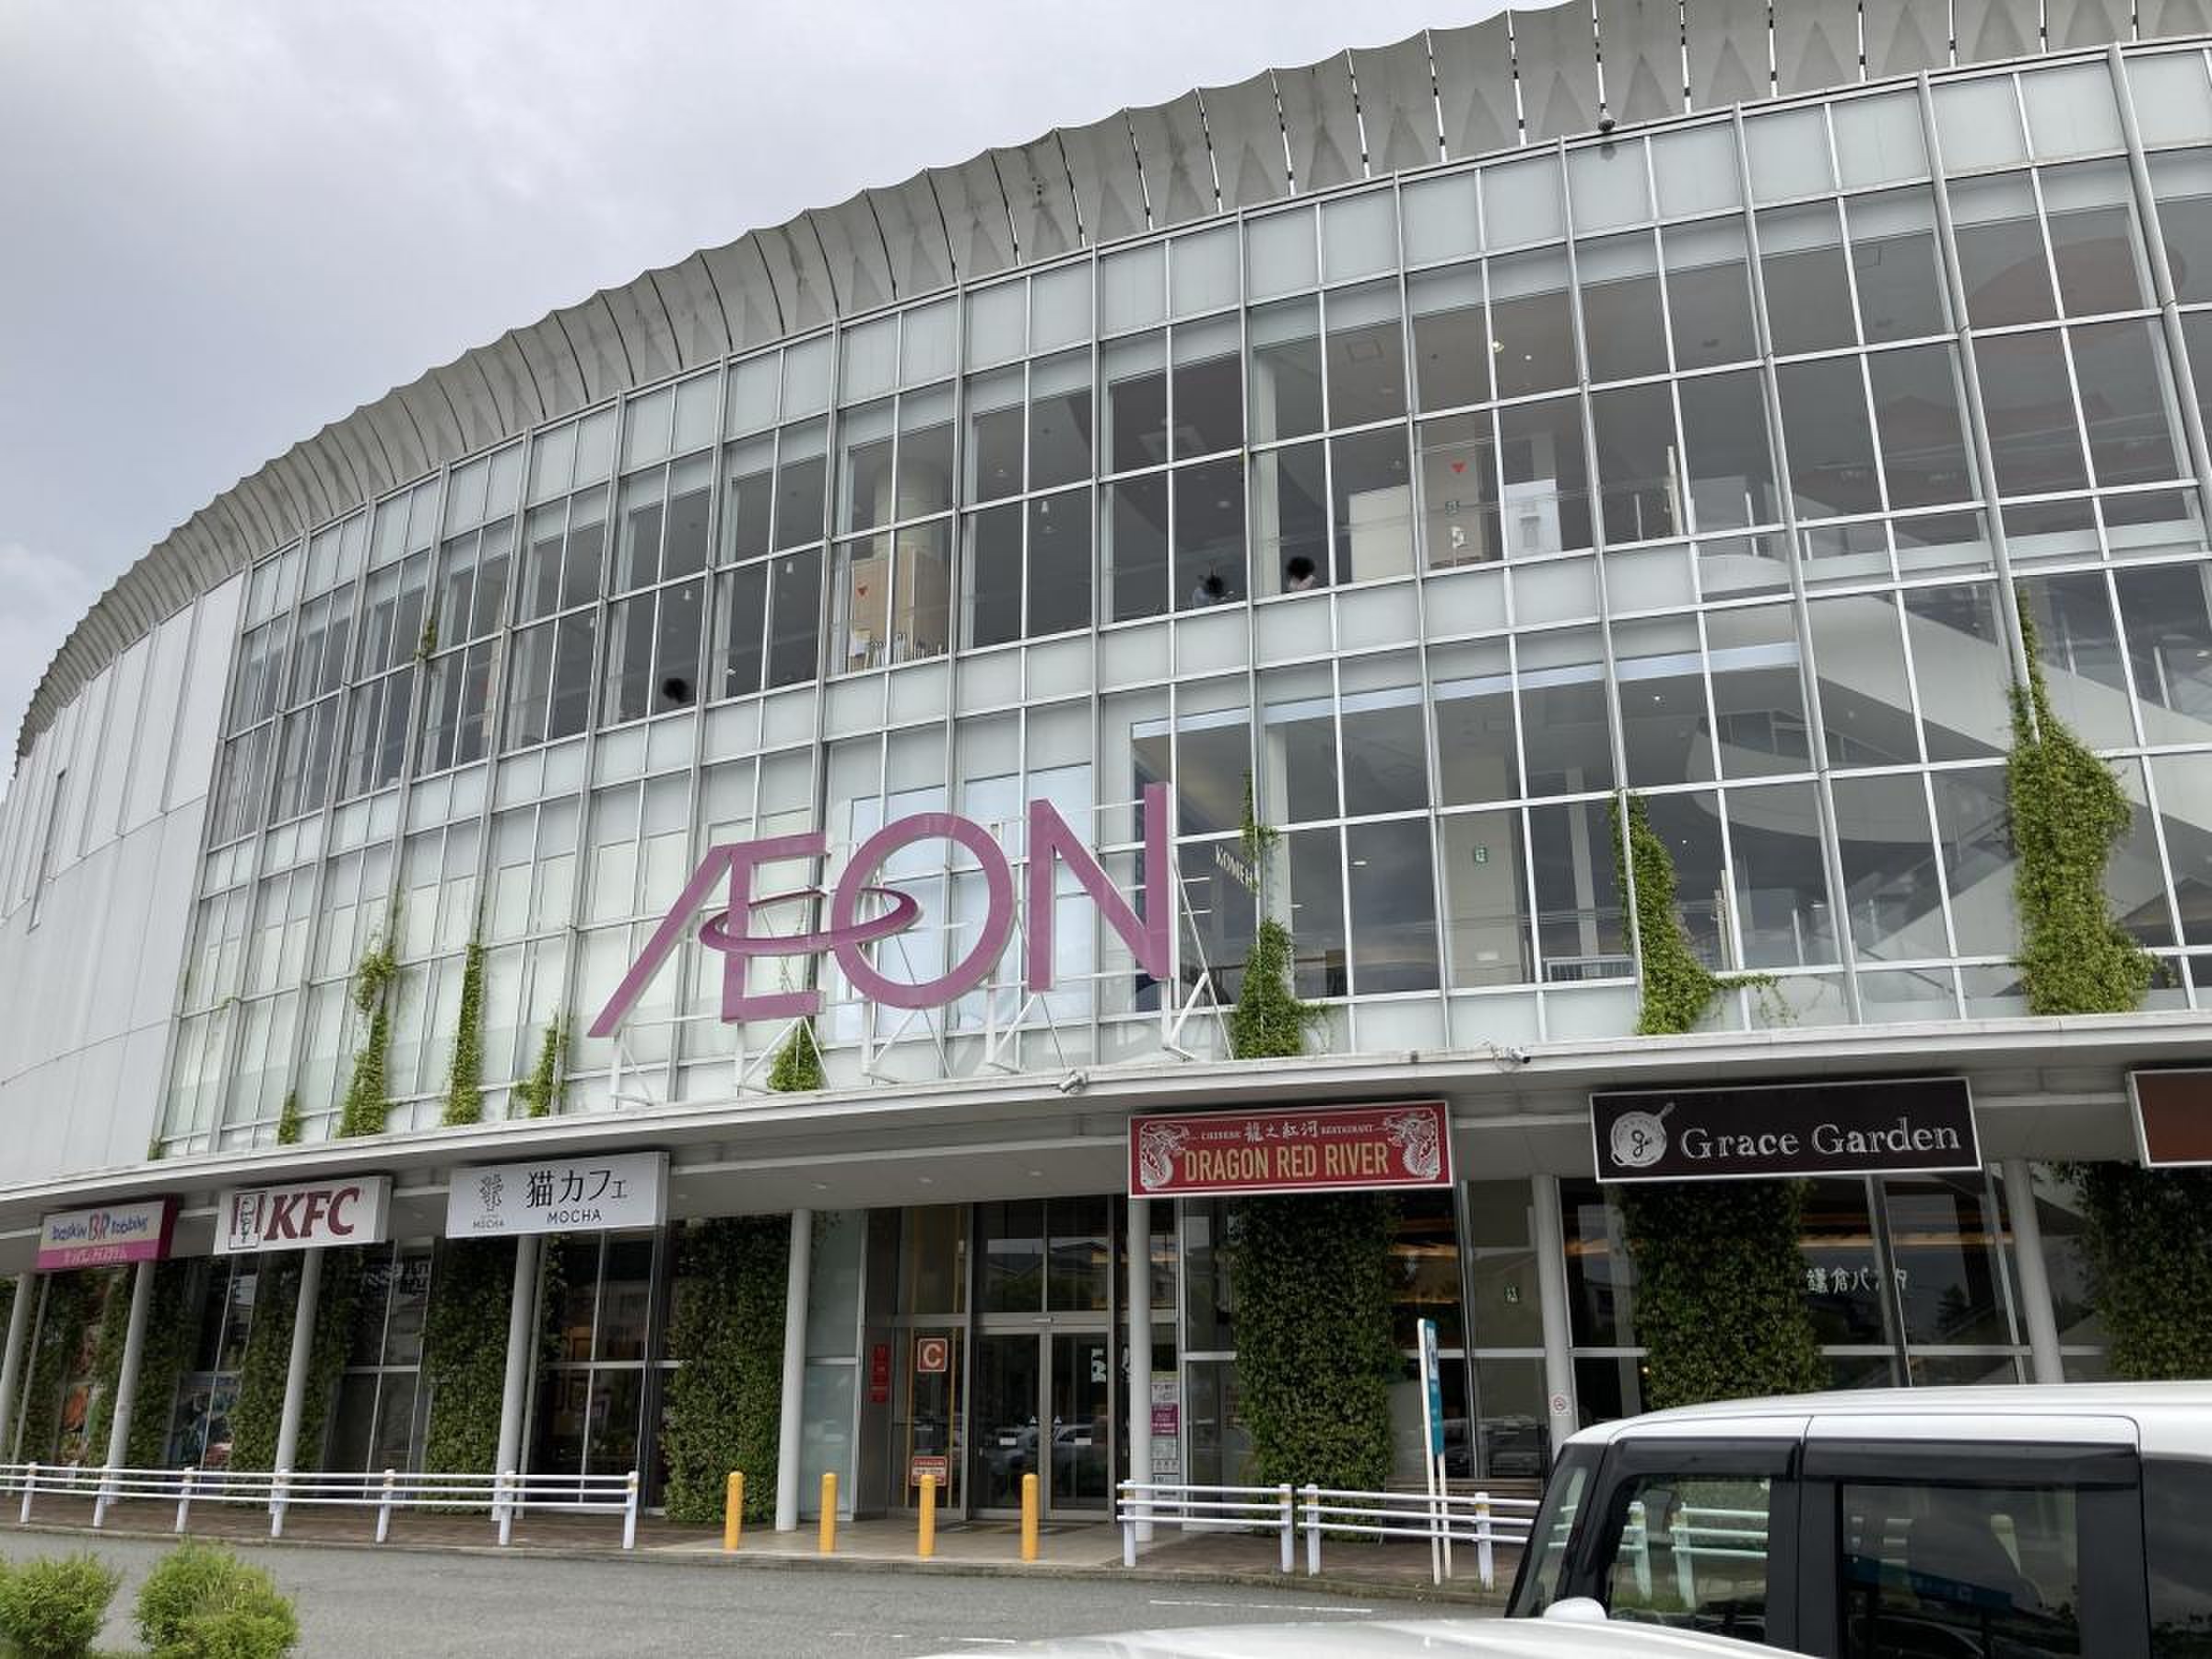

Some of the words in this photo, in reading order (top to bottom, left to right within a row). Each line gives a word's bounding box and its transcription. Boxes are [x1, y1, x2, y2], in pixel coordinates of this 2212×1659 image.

[1680, 1127, 1800, 1159] Grace
[1811, 1116, 1962, 1155] Garden
[1184, 1147, 1269, 1182] DRAGON
[1277, 1144, 1318, 1179] RED
[1324, 1141, 1389, 1177] RIVER
[526, 1169, 629, 1209] 猫カフェ
[264, 1187, 360, 1241] KFC
[547, 1208, 603, 1224] MOCHA
[1806, 1266, 1907, 1294] 鎌倉パタ
[924, 1343, 942, 1368] C
